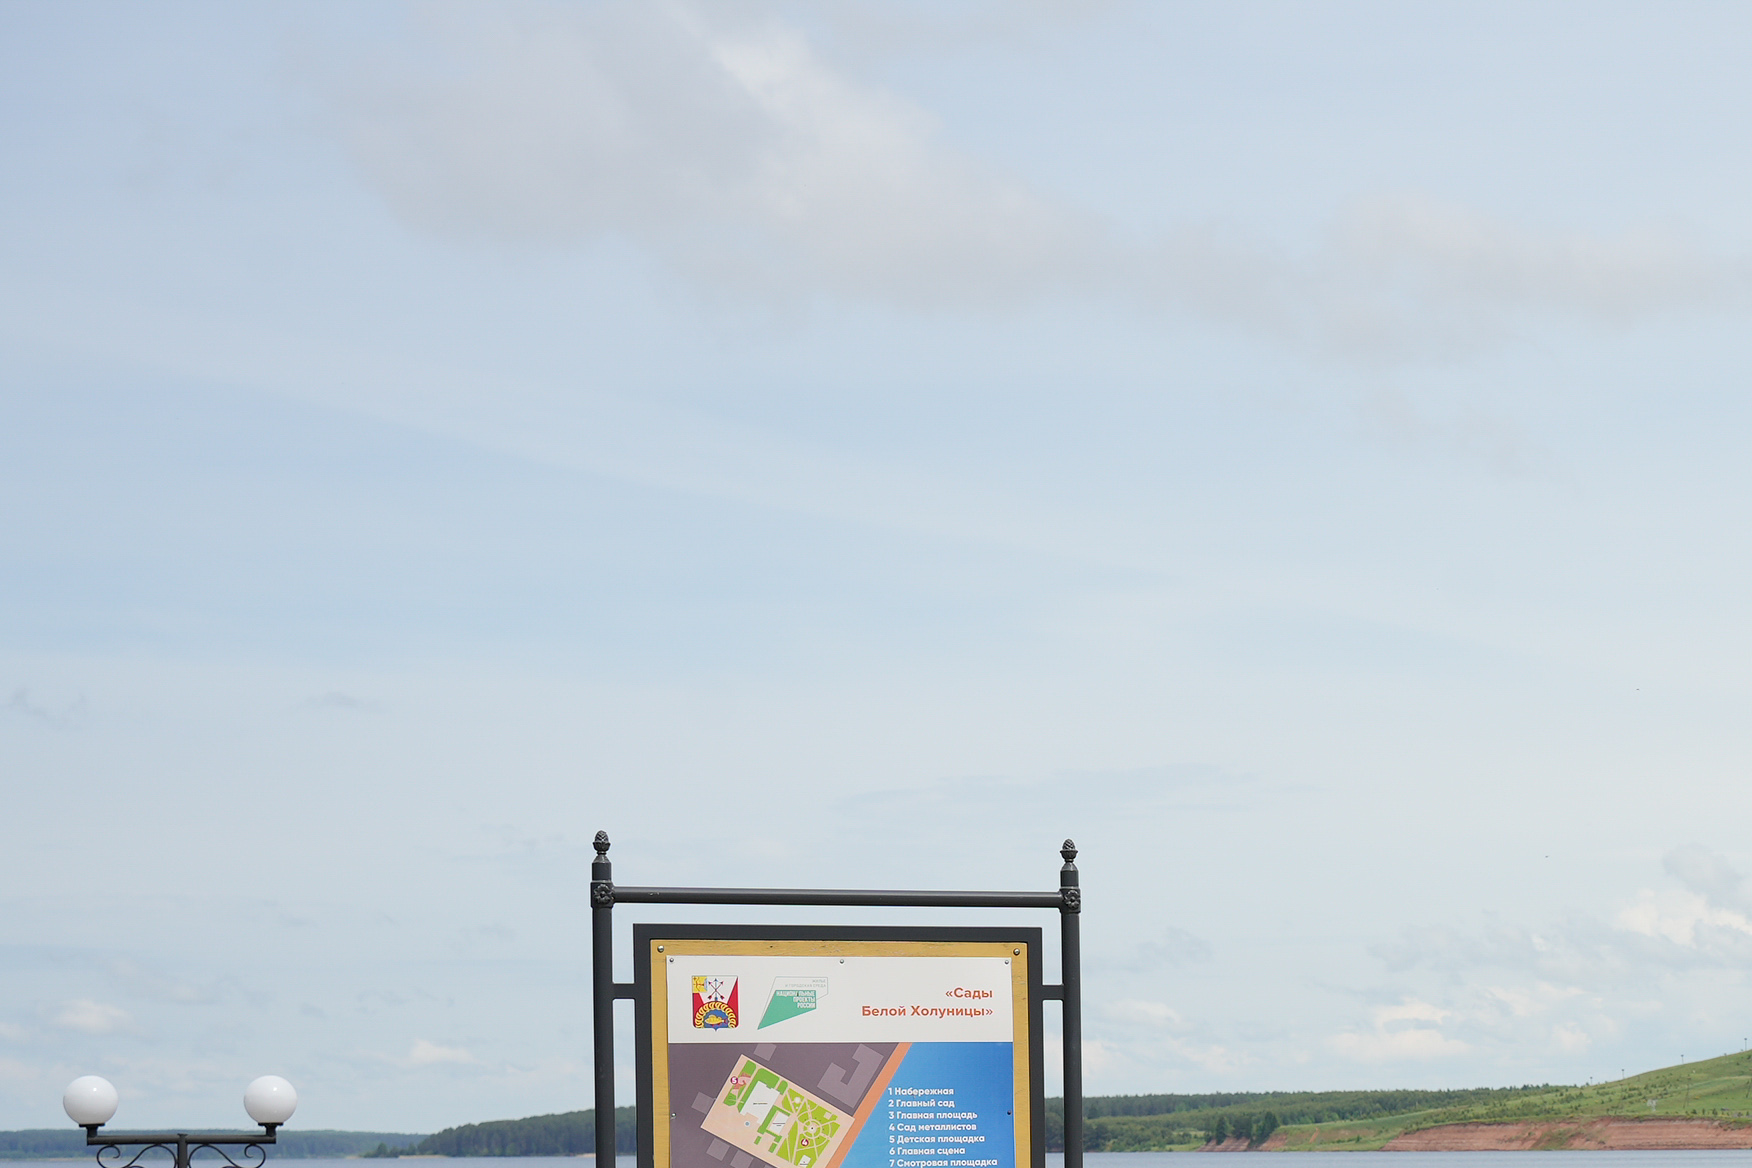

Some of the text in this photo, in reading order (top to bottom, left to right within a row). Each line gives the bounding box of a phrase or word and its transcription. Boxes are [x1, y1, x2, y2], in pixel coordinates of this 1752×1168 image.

[945, 986, 993, 1000] «Сады
[862, 1005, 994, 1019] Белой Холуницы»
[895, 1087, 954, 1096] Набережная
[896, 1099, 936, 1107] Главный
[937, 1100, 955, 1108] сад
[896, 1111, 935, 1120] Главная
[936, 1112, 978, 1120] площадь
[897, 1123, 917, 1132] Сад
[897, 1135, 936, 1144] Детская
[937, 1136, 985, 1144] площадка
[897, 1147, 935, 1155] Главная
[897, 1158, 949, 1168] Смотровая
[950, 1159, 998, 1168] площадка
